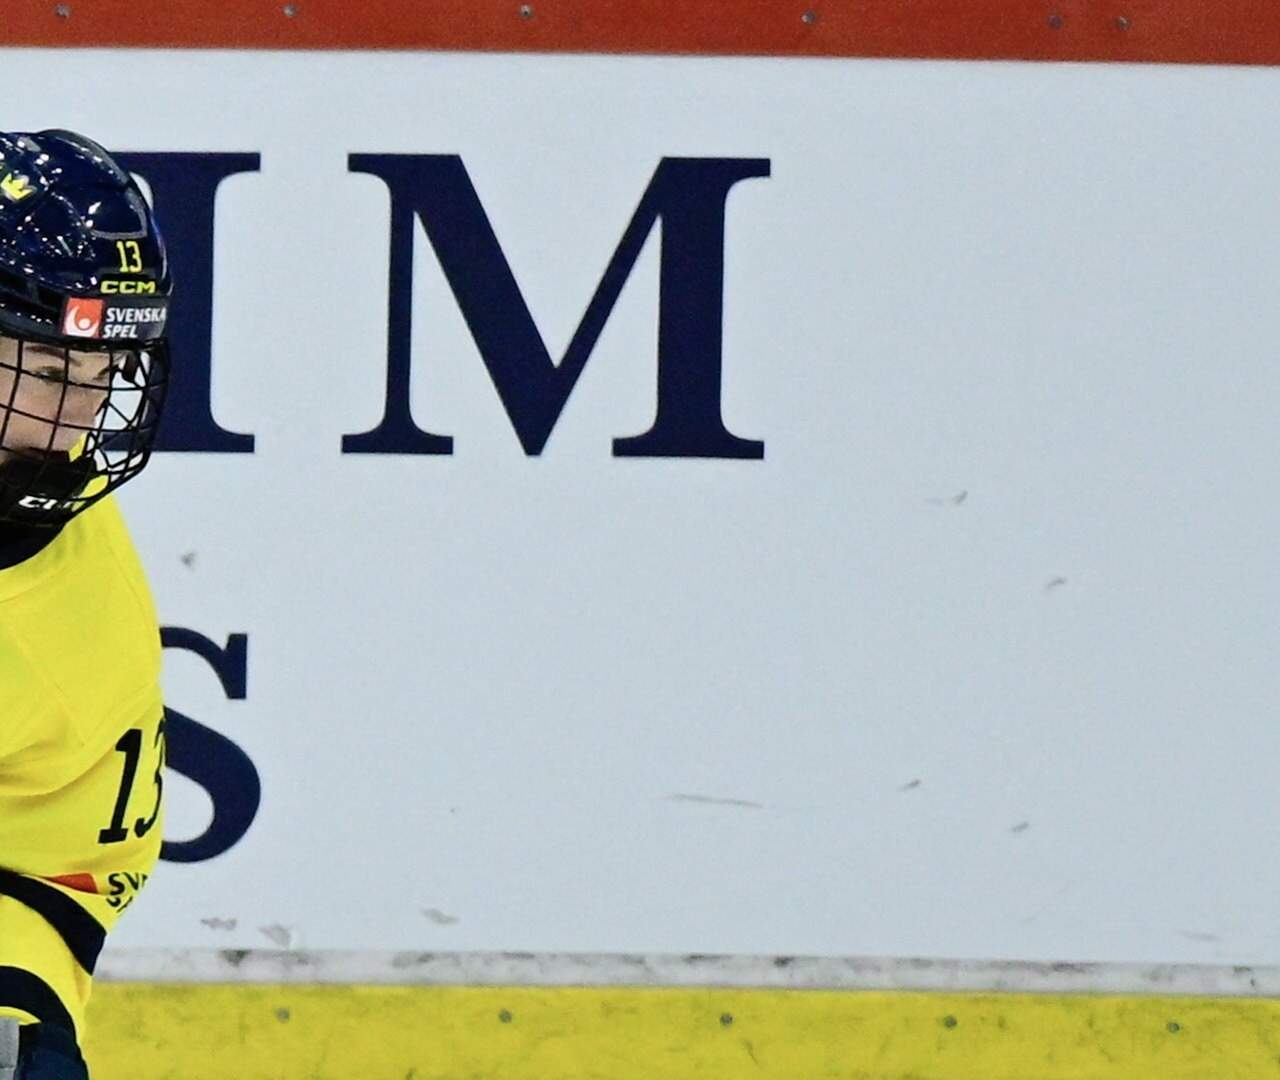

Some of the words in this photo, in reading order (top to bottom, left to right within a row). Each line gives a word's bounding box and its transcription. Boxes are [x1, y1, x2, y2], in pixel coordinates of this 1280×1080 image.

[116, 240, 143, 273] 13
[100, 280, 156, 294] CCM
[105, 307, 167, 323] SVENSKA
[102, 324, 139, 339] SPEL
[98, 720, 164, 845] 13
[107, 871, 149, 896] SV
